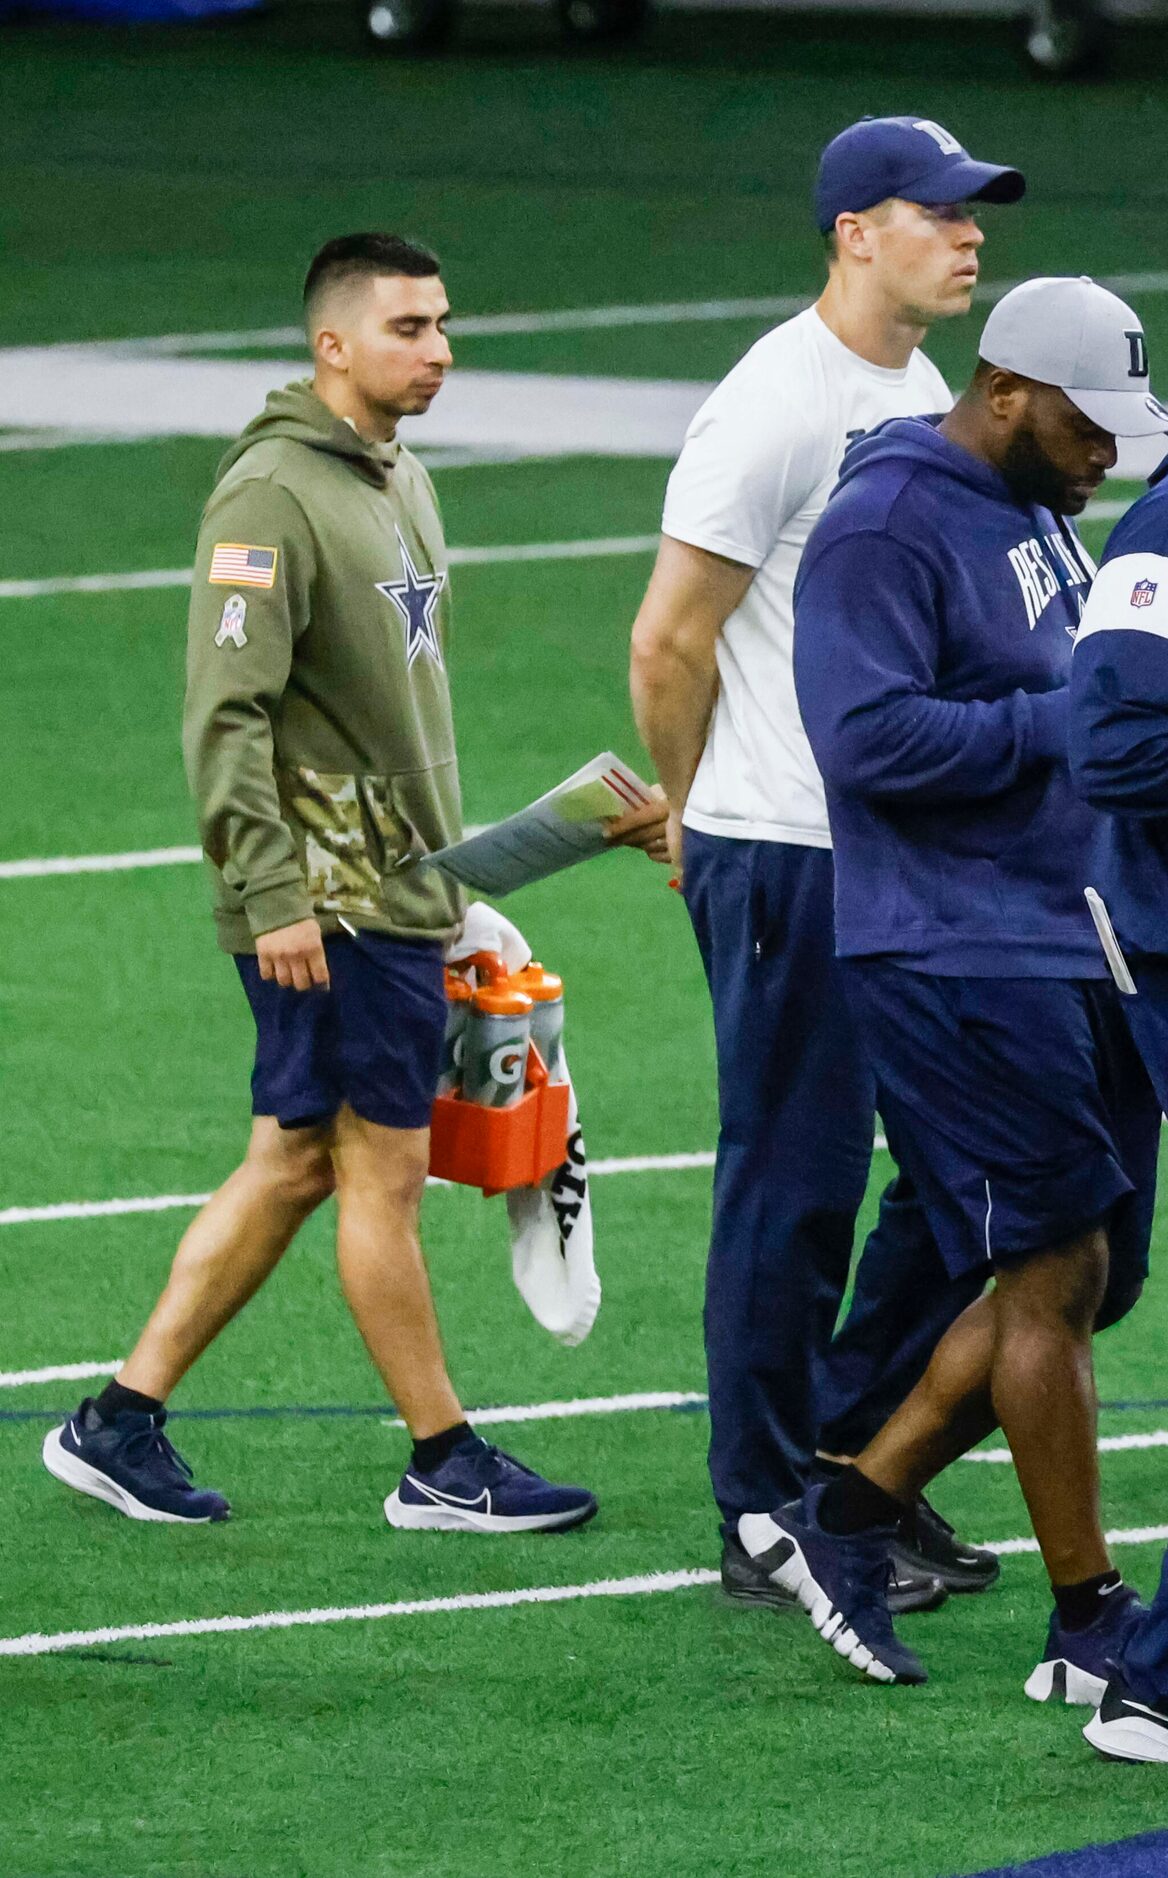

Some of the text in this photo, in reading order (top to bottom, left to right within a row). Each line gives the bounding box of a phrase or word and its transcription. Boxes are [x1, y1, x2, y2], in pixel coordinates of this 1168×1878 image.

[1123, 330, 1148, 377] D
[1132, 591, 1152, 605] NFL
[489, 1044, 525, 1085] G
